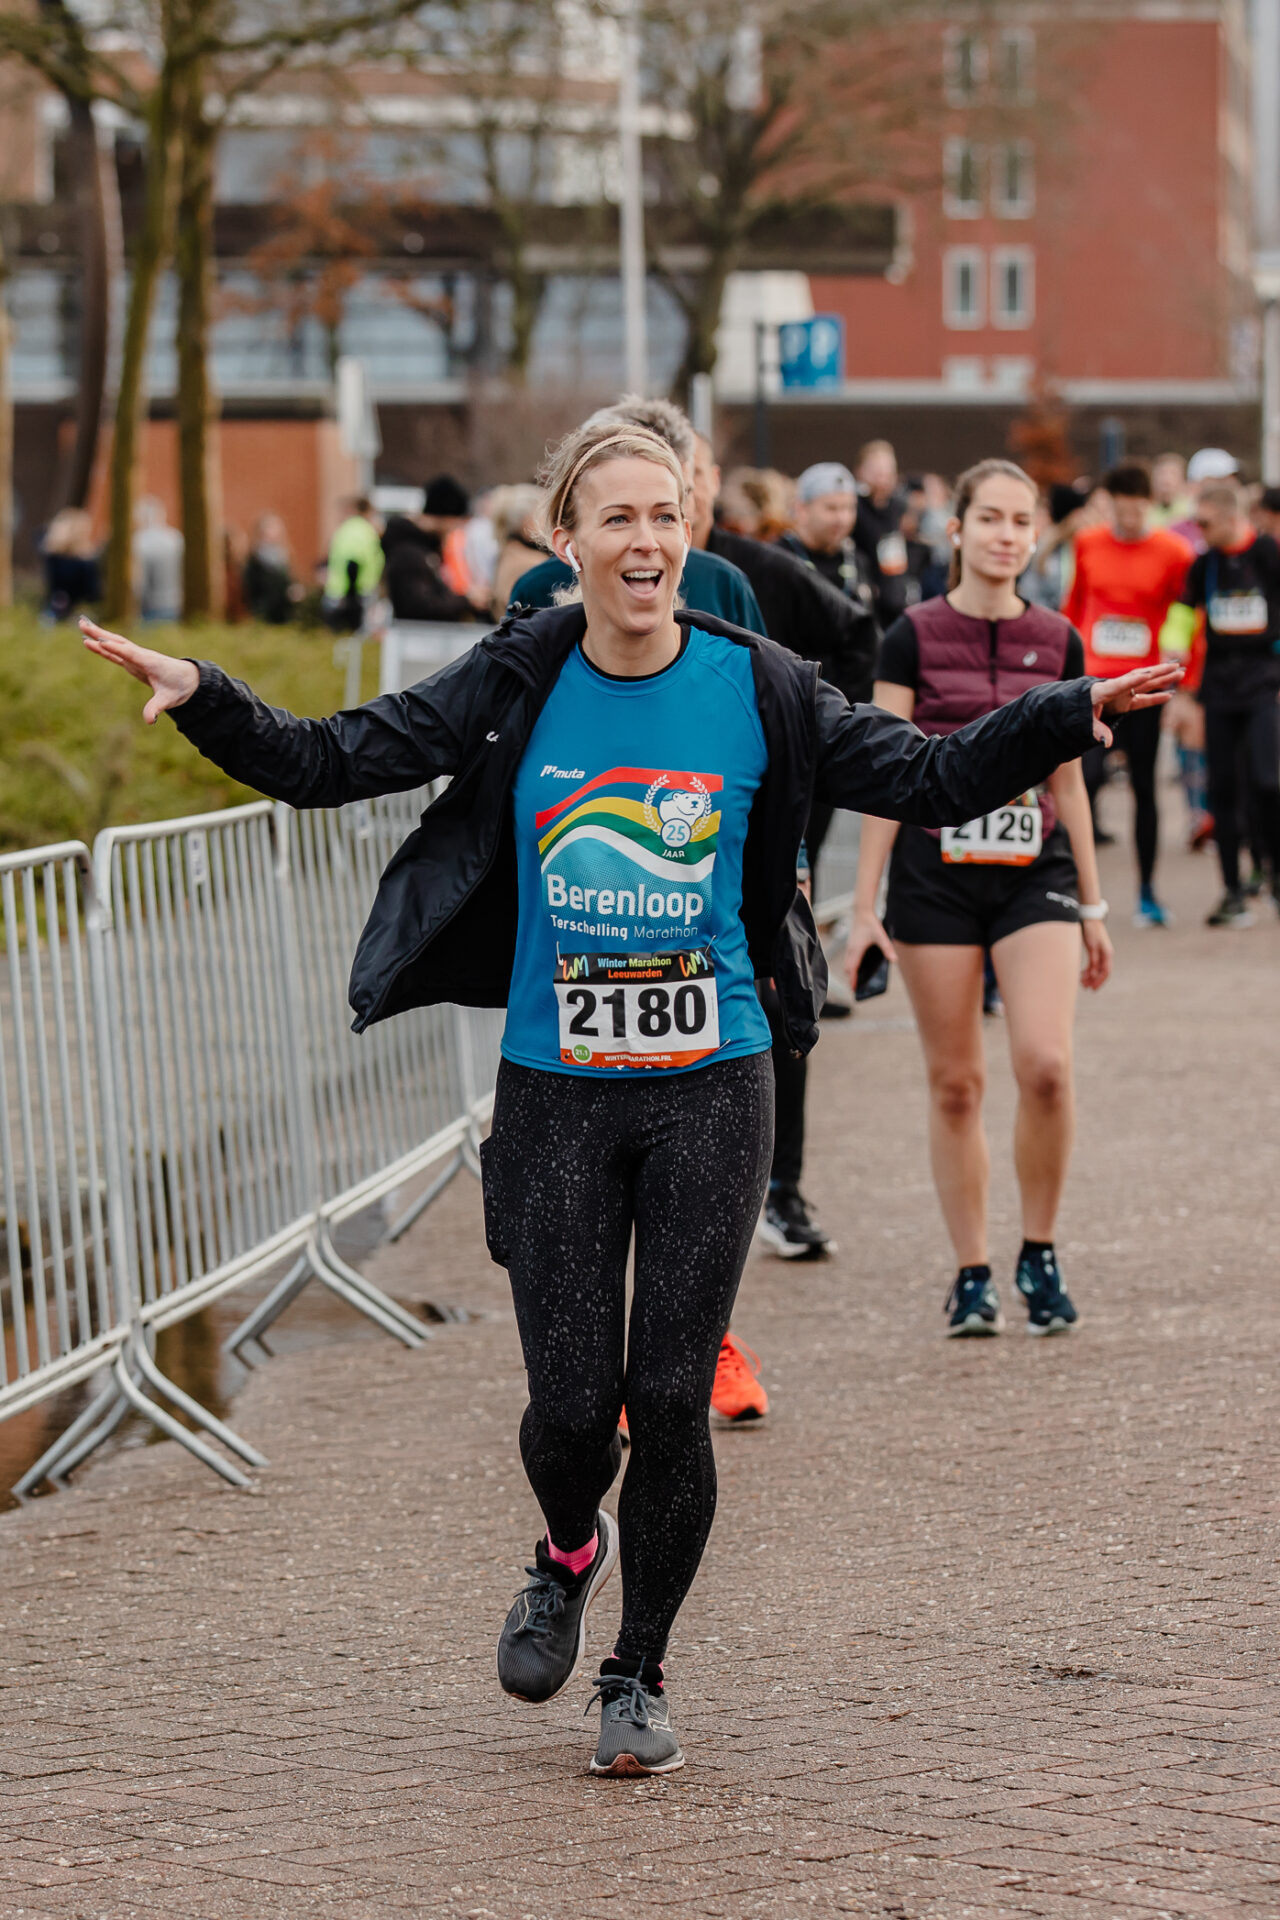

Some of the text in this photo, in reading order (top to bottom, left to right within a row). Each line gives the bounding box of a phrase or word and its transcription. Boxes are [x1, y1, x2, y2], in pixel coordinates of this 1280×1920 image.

[553, 768, 586, 779] muta
[666, 824, 686, 841] 25
[662, 849, 685, 858] JAAR
[547, 874, 704, 925] Berenloop
[550, 914, 699, 941] Terschelling Marathon
[597, 957, 672, 968] Winter Marathon
[608, 968, 662, 979] Leeuwarden
[566, 984, 707, 1038] 2180
